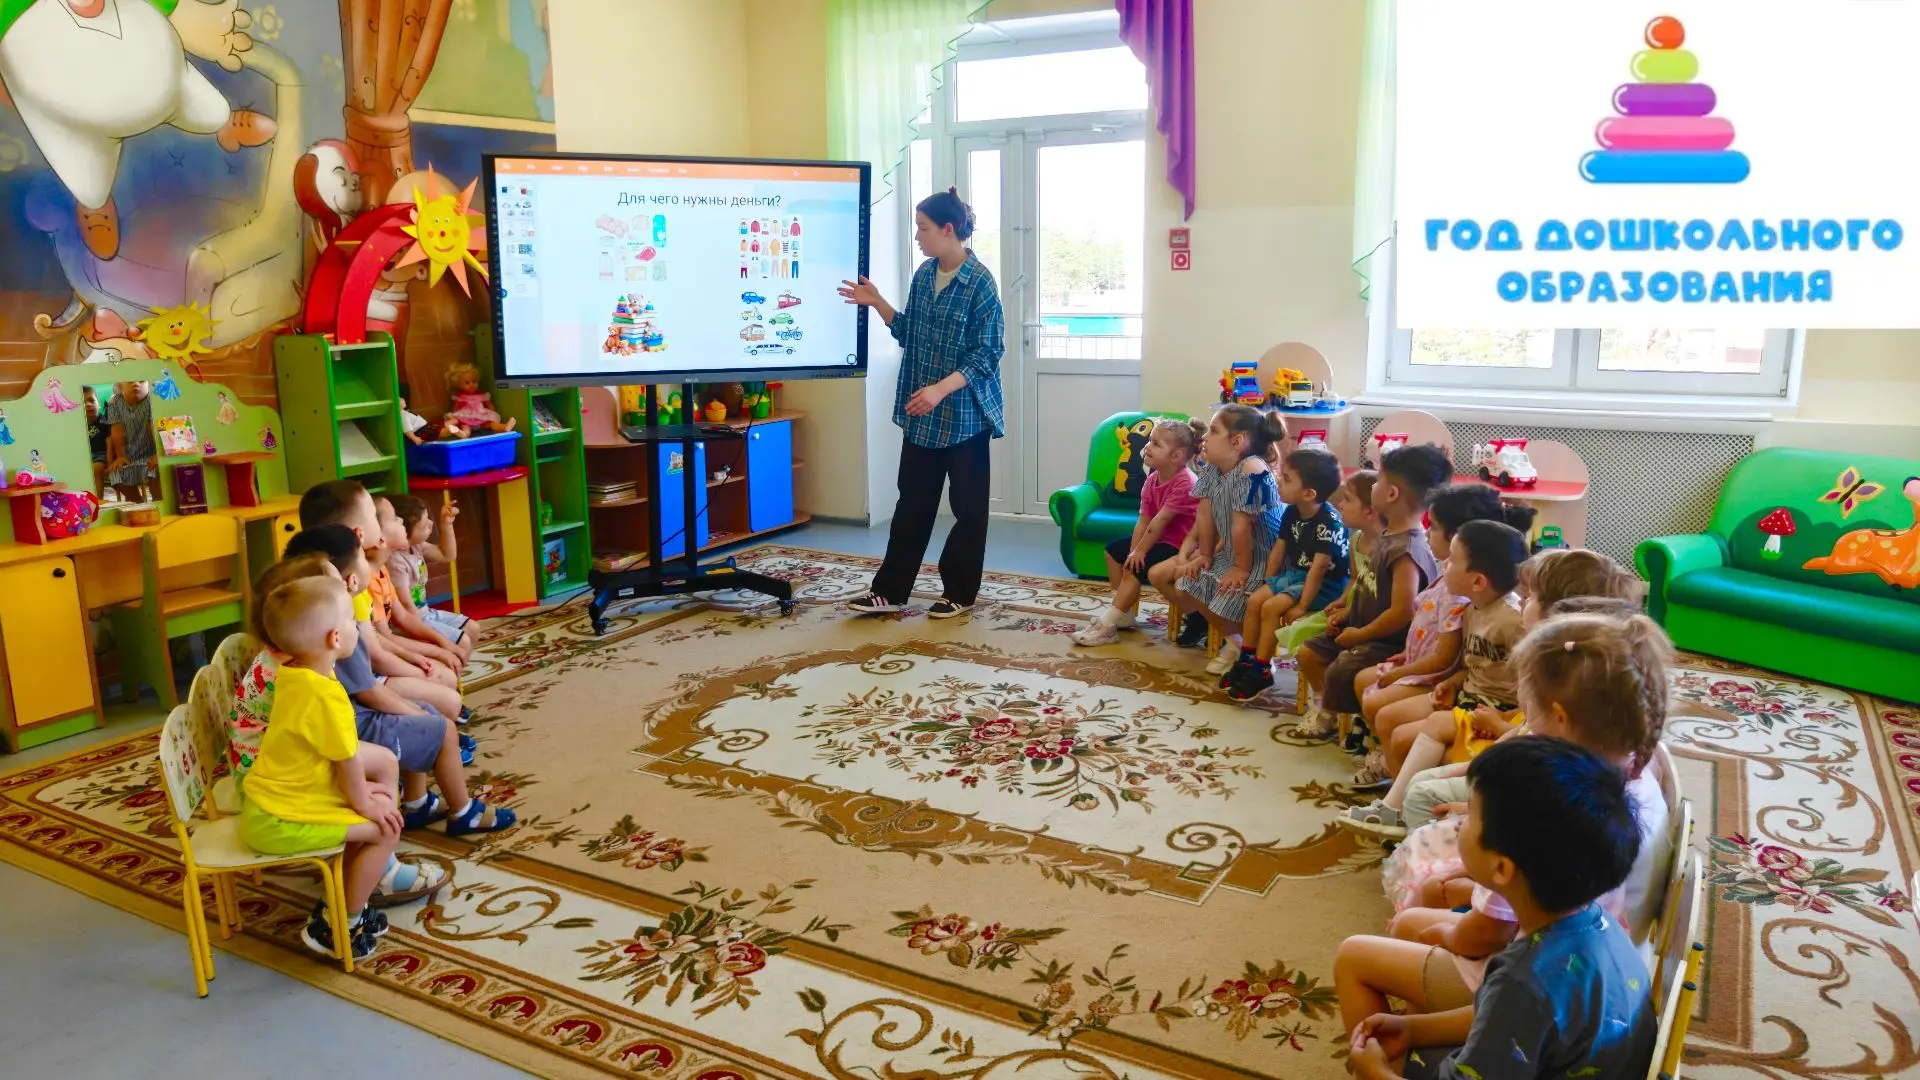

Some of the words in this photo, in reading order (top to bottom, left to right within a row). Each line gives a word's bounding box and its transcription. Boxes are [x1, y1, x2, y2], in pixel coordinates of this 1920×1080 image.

[617, 191, 646, 206] Для
[649, 195, 679, 205] чего
[683, 196, 727, 208] нужны
[730, 194, 782, 208] деньги?
